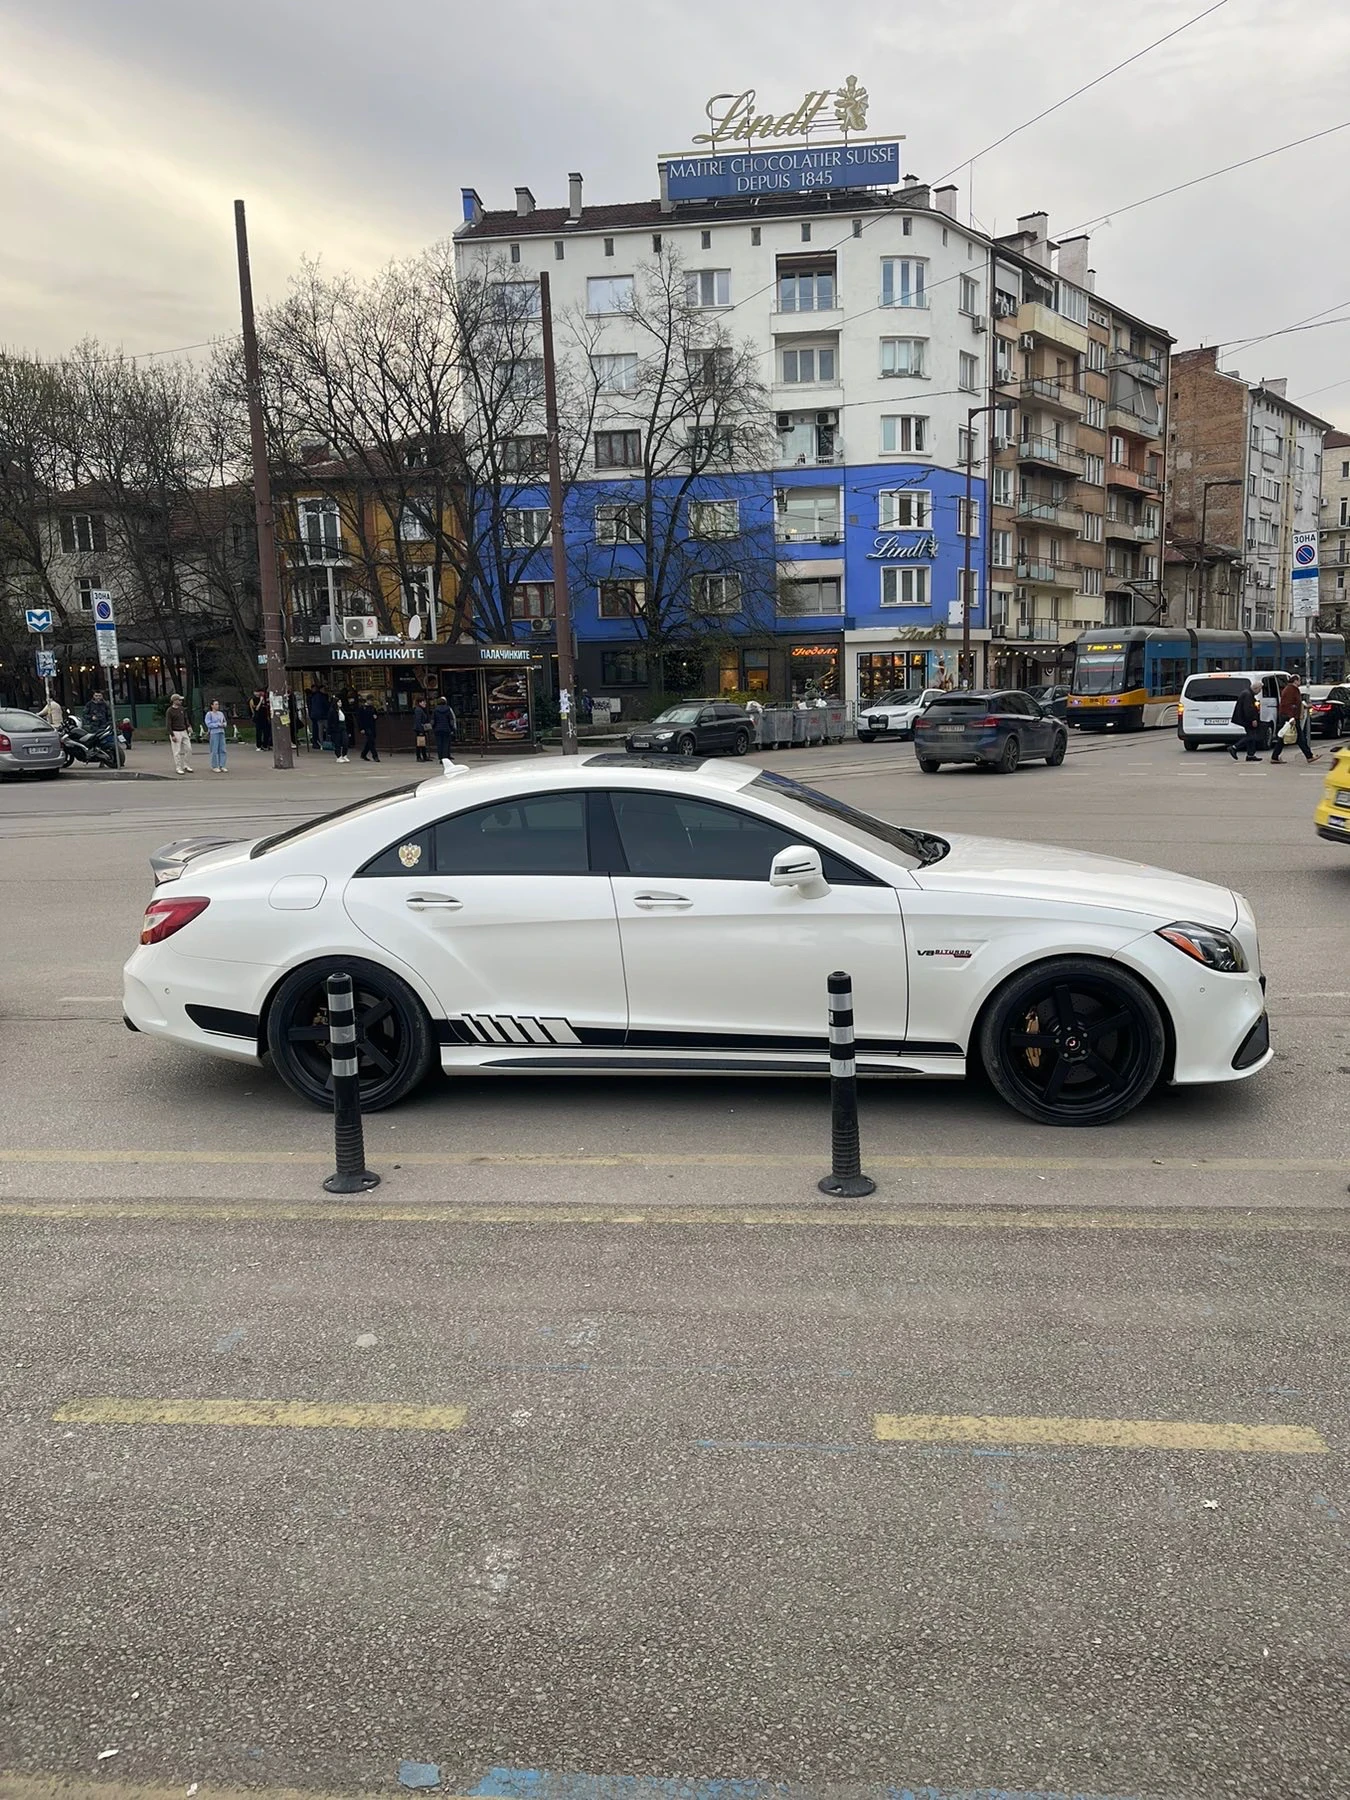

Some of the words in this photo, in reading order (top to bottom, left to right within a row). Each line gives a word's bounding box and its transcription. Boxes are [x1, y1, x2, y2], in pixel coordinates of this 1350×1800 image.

[692, 89, 830, 144] Lindt
[670, 159, 727, 179] MAÎTRE
[731, 151, 842, 174] CHOCOLATIER
[846, 147, 895, 165] SUISSE
[738, 173, 790, 192] DEPUIS
[799, 170, 833, 187] 1845
[866, 535, 927, 558] Lindt
[1294, 534, 1316, 544] ЗОНА
[94, 592, 110, 600] ЗОНА
[331, 648, 425, 660] ПАЛАЧИНКИТЕ
[480, 649, 530, 660] ПАЛАЧИНКИТЕ
